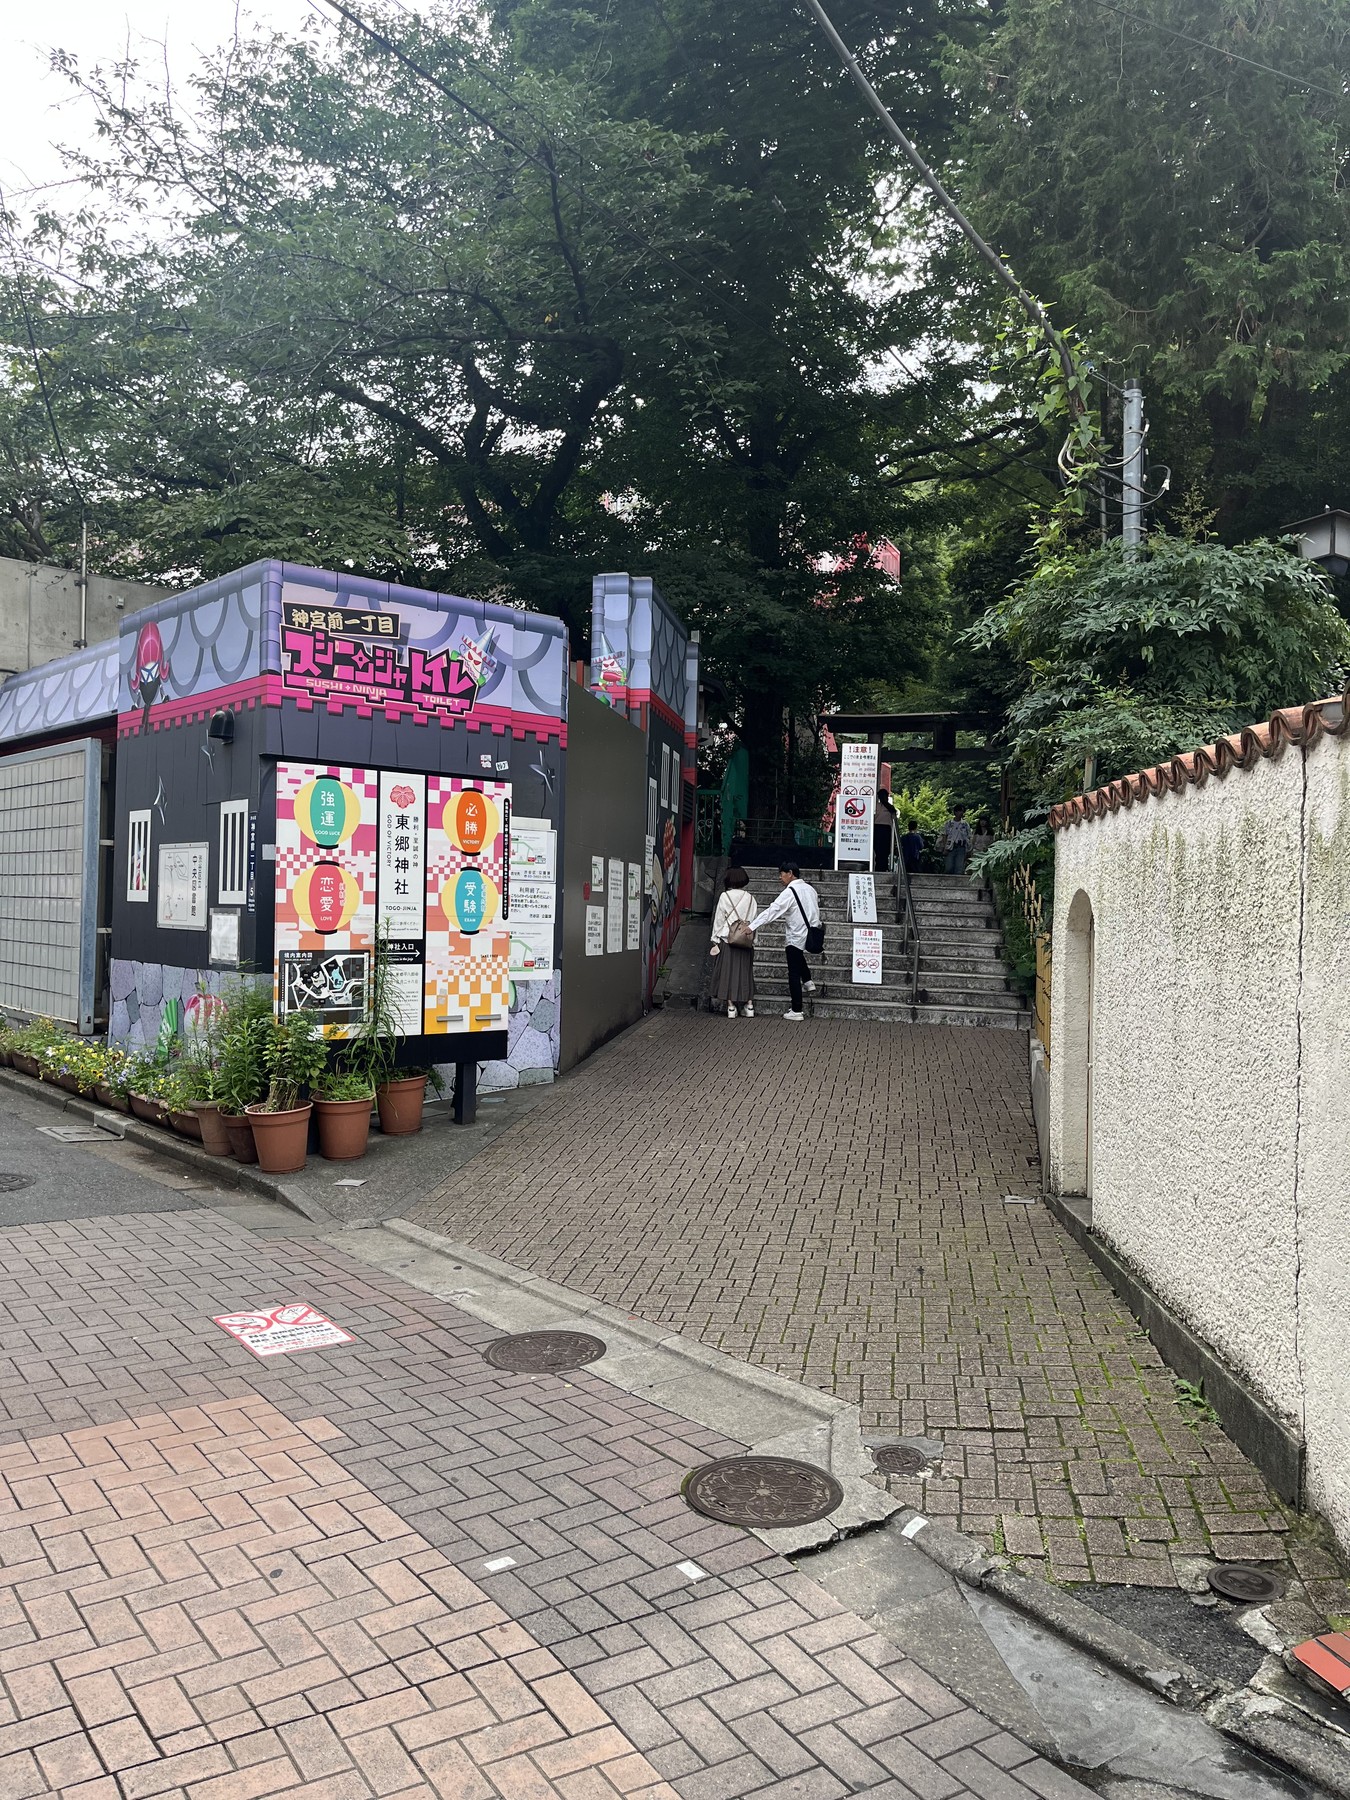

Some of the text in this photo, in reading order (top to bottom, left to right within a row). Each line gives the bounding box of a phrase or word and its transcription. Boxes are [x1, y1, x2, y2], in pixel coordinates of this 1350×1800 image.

[292, 608, 394, 634] 神宮前一丁目
[306, 678, 388, 700] SUSHI NINJA
[423, 694, 461, 707] TOILET
[320, 790, 336, 827] 強運
[465, 802, 478, 836] 必勝
[387, 830, 392, 839] OF
[394, 813, 410, 895] 東郷神社
[320, 877, 334, 912] 恋愛
[464, 882, 477, 913] 受験
